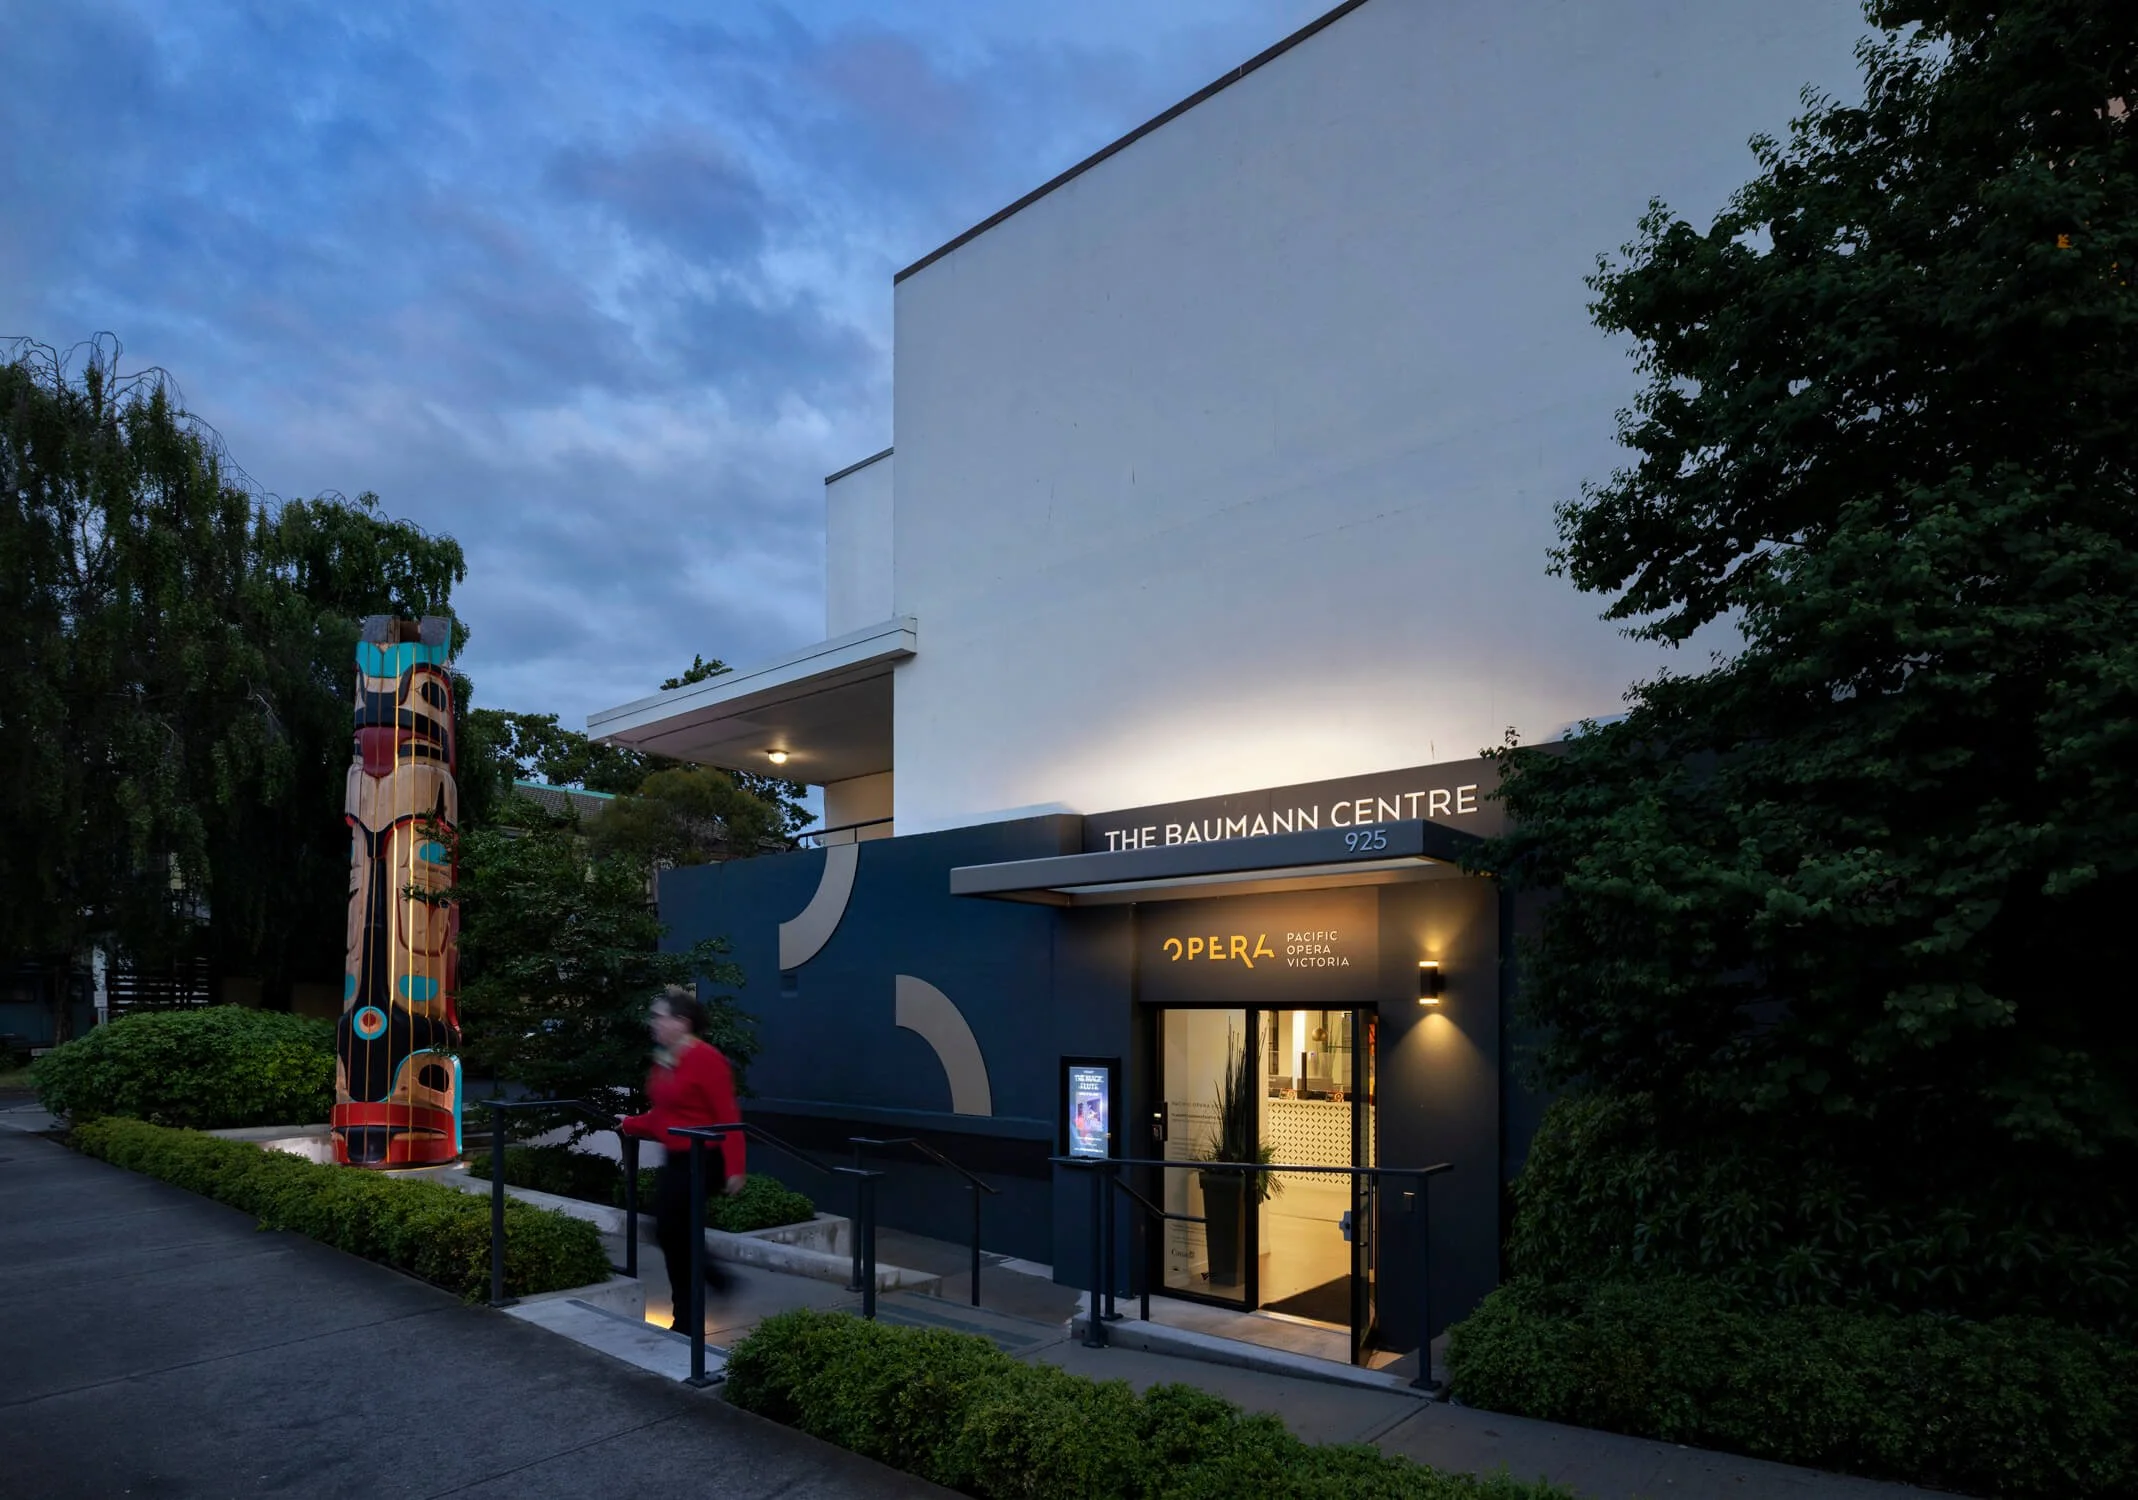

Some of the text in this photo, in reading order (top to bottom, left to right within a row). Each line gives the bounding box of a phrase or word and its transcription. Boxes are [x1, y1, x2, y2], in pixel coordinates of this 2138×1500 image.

[1104, 784, 1479, 852] THE BAUMANN CENTRE
[1345, 829, 1387, 852] 925
[1286, 930, 1339, 943] PACIFIC
[1163, 933, 1275, 969] OPERA
[1286, 944, 1332, 956] OPERA
[1286, 956, 1351, 968] VICTORIA
